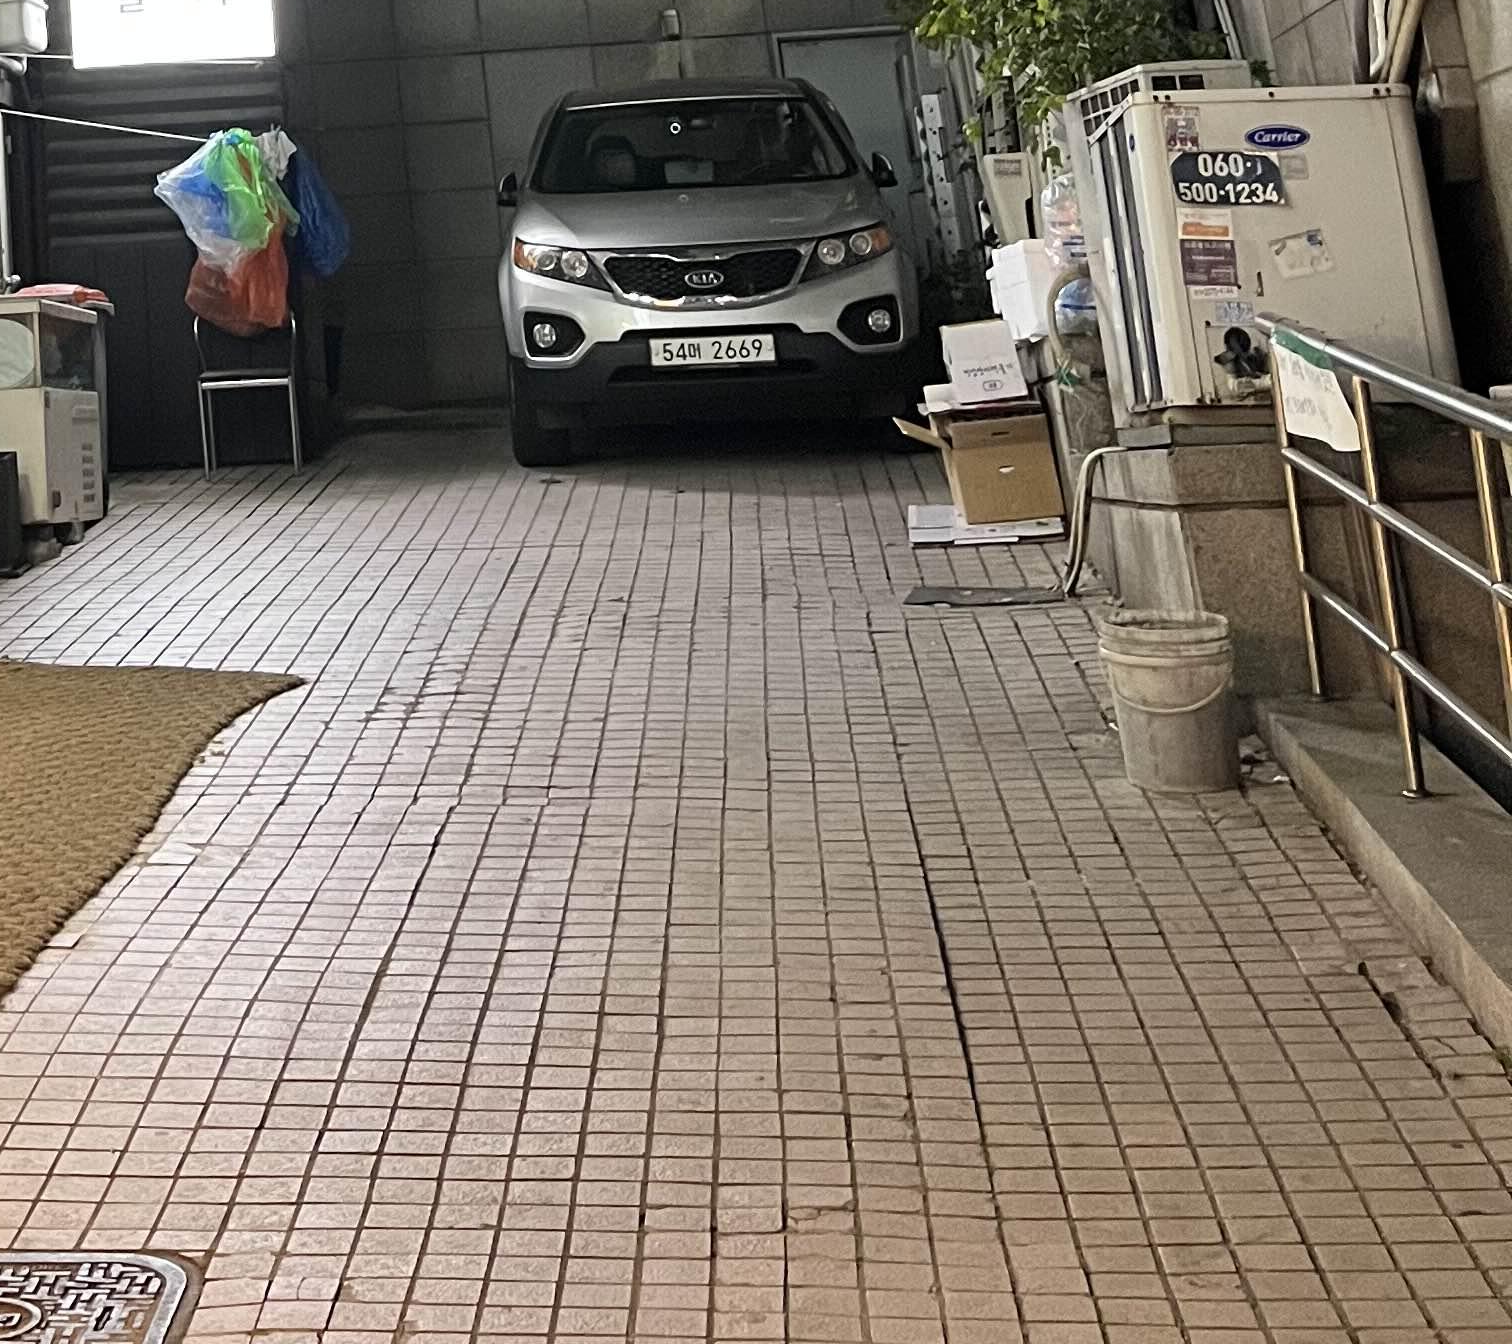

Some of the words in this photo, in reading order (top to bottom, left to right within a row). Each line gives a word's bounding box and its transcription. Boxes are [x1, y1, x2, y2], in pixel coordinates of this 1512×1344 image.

[1253, 130, 1301, 144] Carrier
[692, 273, 718, 284] KIA
[711, 338, 763, 360] 2669
